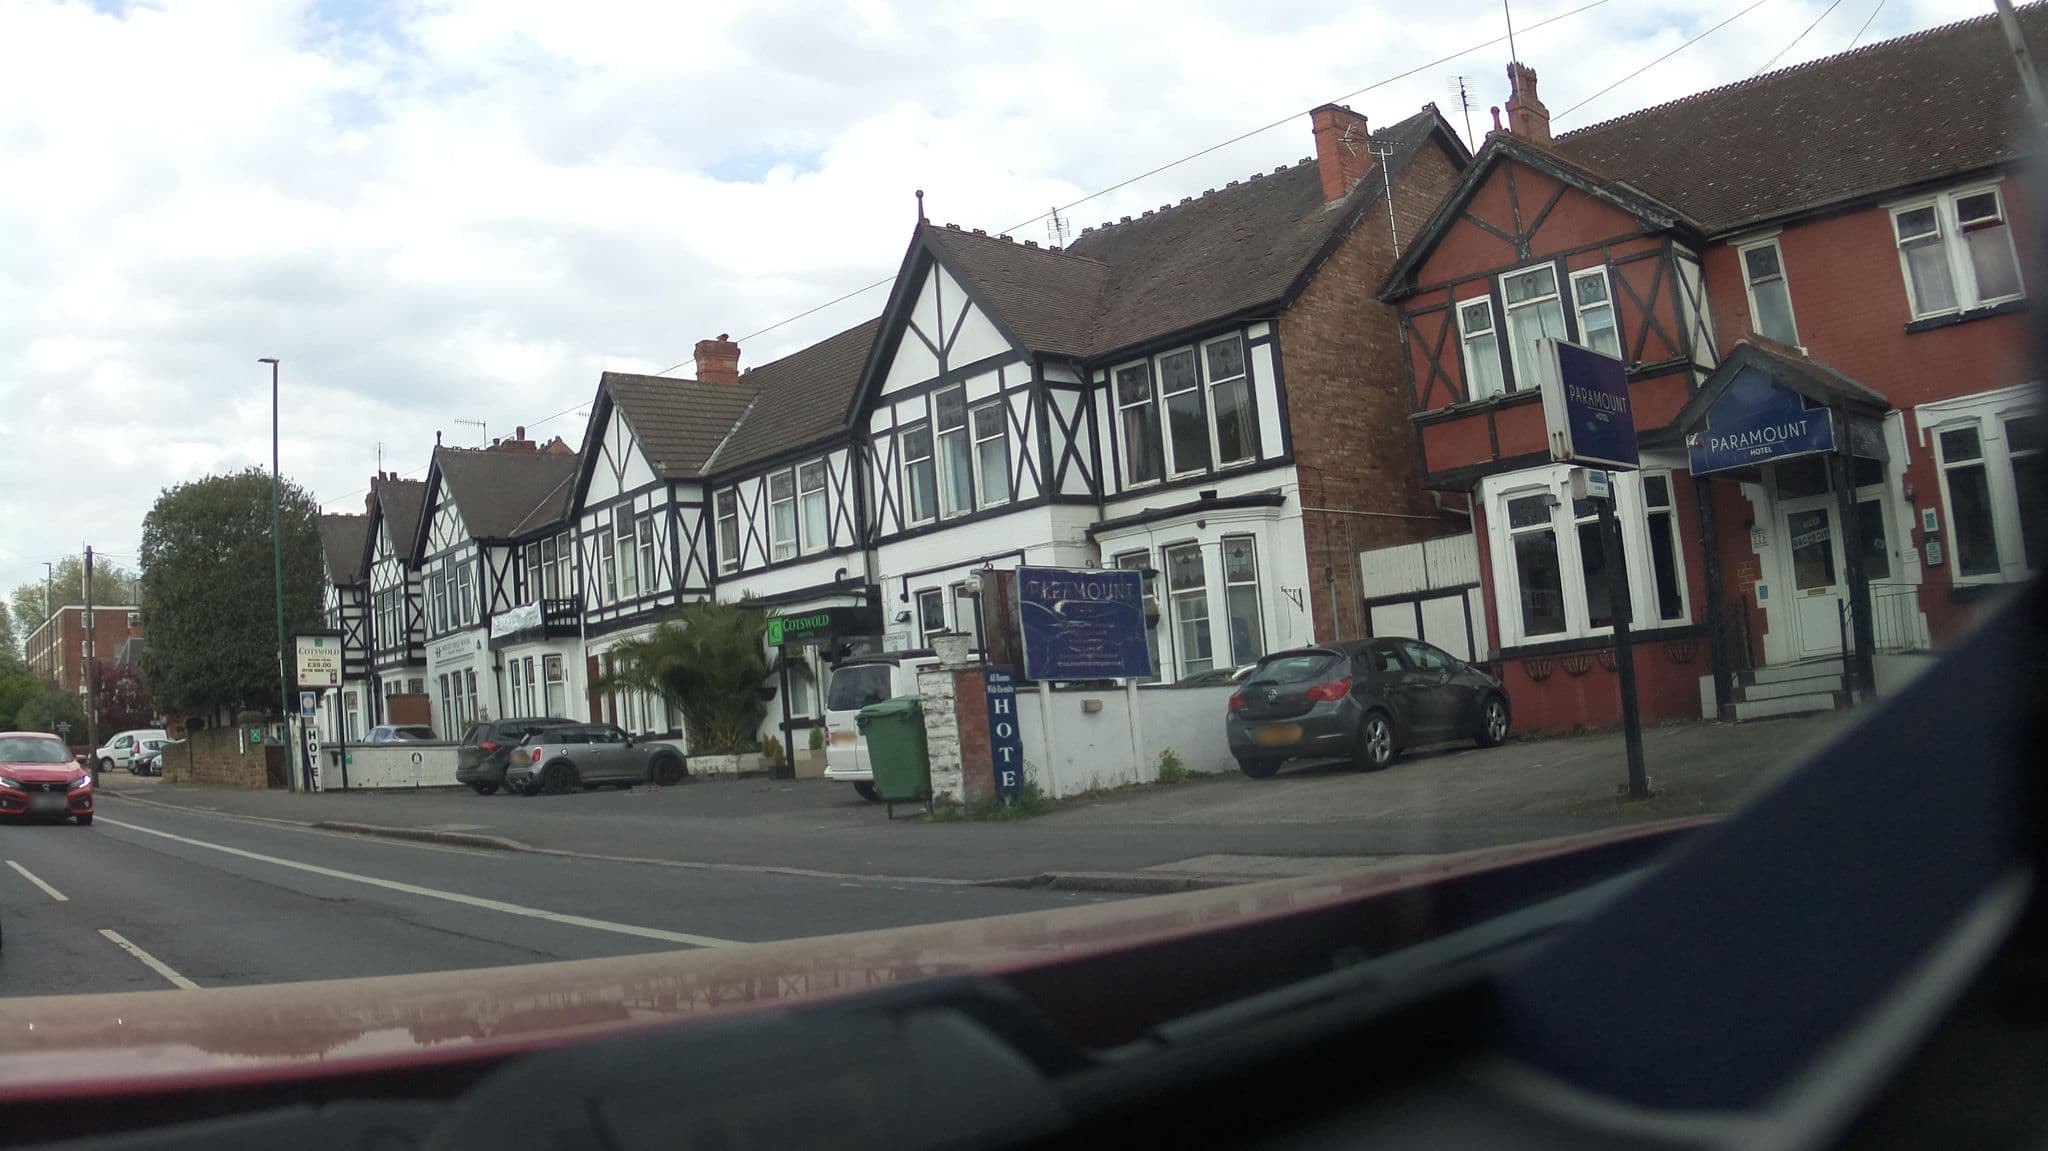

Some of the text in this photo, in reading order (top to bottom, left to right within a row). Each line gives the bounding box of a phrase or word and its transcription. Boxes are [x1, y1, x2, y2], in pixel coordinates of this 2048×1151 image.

[1569, 384, 1627, 415] PARAMOUNT
[1711, 420, 1808, 453] PARAMOUNT
[1750, 446, 1773, 456] HOTEL
[782, 615, 829, 632] COTSWOLD
[308, 730, 319, 790] HOTE
[994, 698, 1016, 806] HOTE
